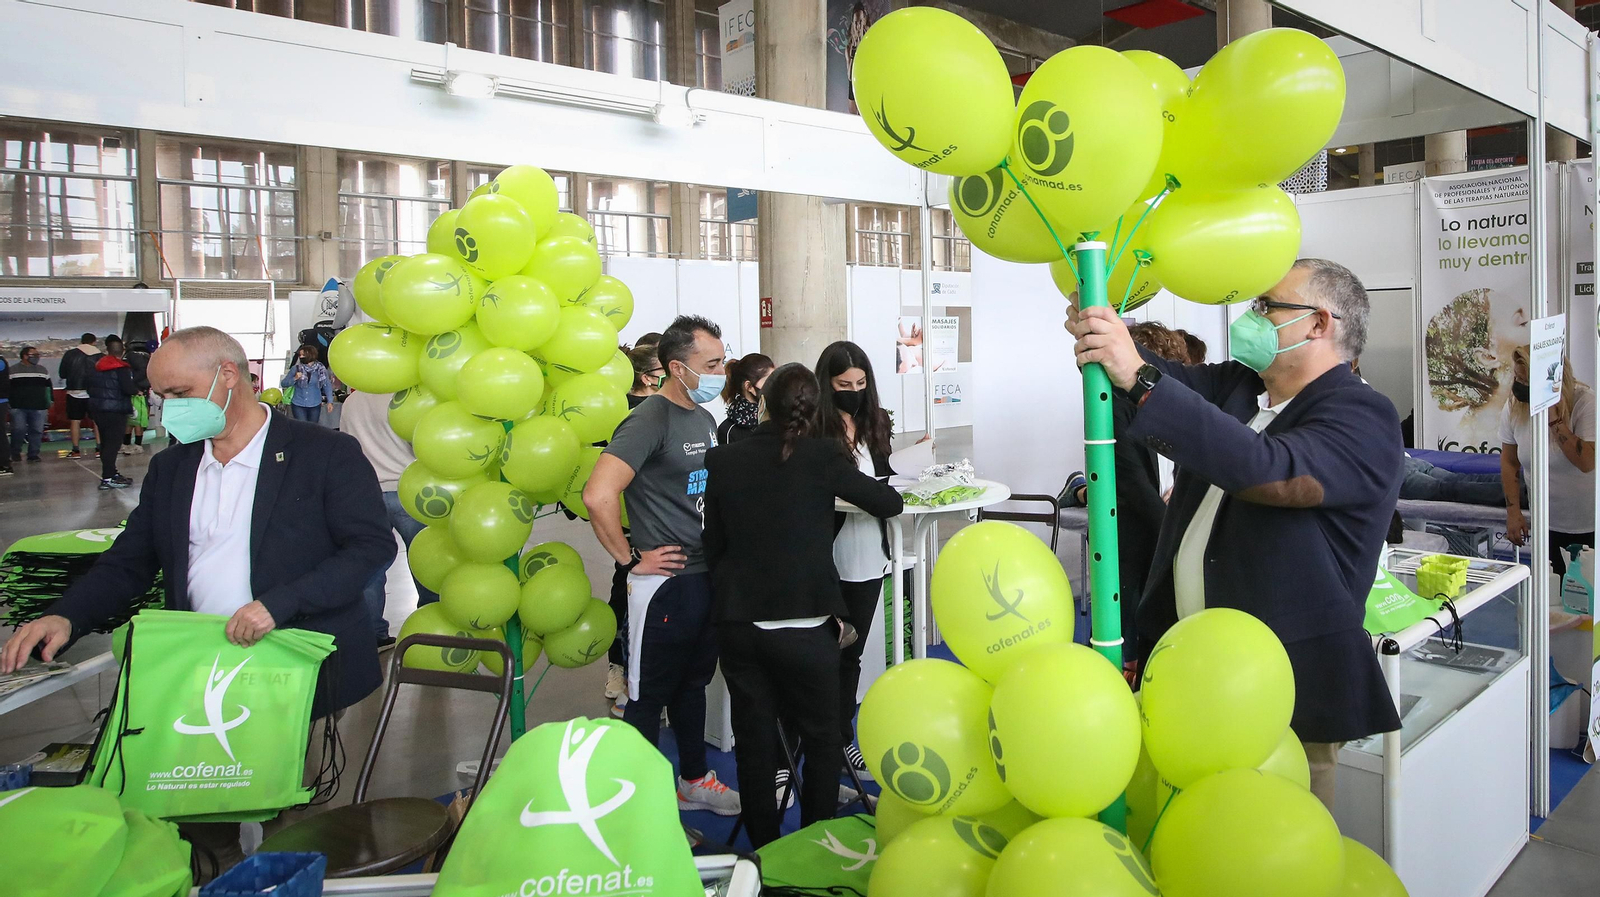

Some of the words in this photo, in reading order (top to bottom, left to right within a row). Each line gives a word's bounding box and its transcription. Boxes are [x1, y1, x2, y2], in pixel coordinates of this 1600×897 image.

[1387, 169, 1422, 183] IFECA
[1489, 176, 1523, 186] NACIONAL
[1444, 187, 1491, 199] PROFESIONALES
[1465, 194, 1493, 203] TERAPIAS
[1494, 189, 1529, 200] NATURALES
[1441, 218, 1461, 232] Lo
[1467, 213, 1527, 231] natura
[1438, 237, 1452, 251] lo
[1457, 233, 1529, 249] llevamo
[1439, 256, 1472, 272] muy
[1478, 251, 1529, 267] dentr
[986, 618, 1052, 654] cofenat.es
[220, 780, 251, 789] regulado
